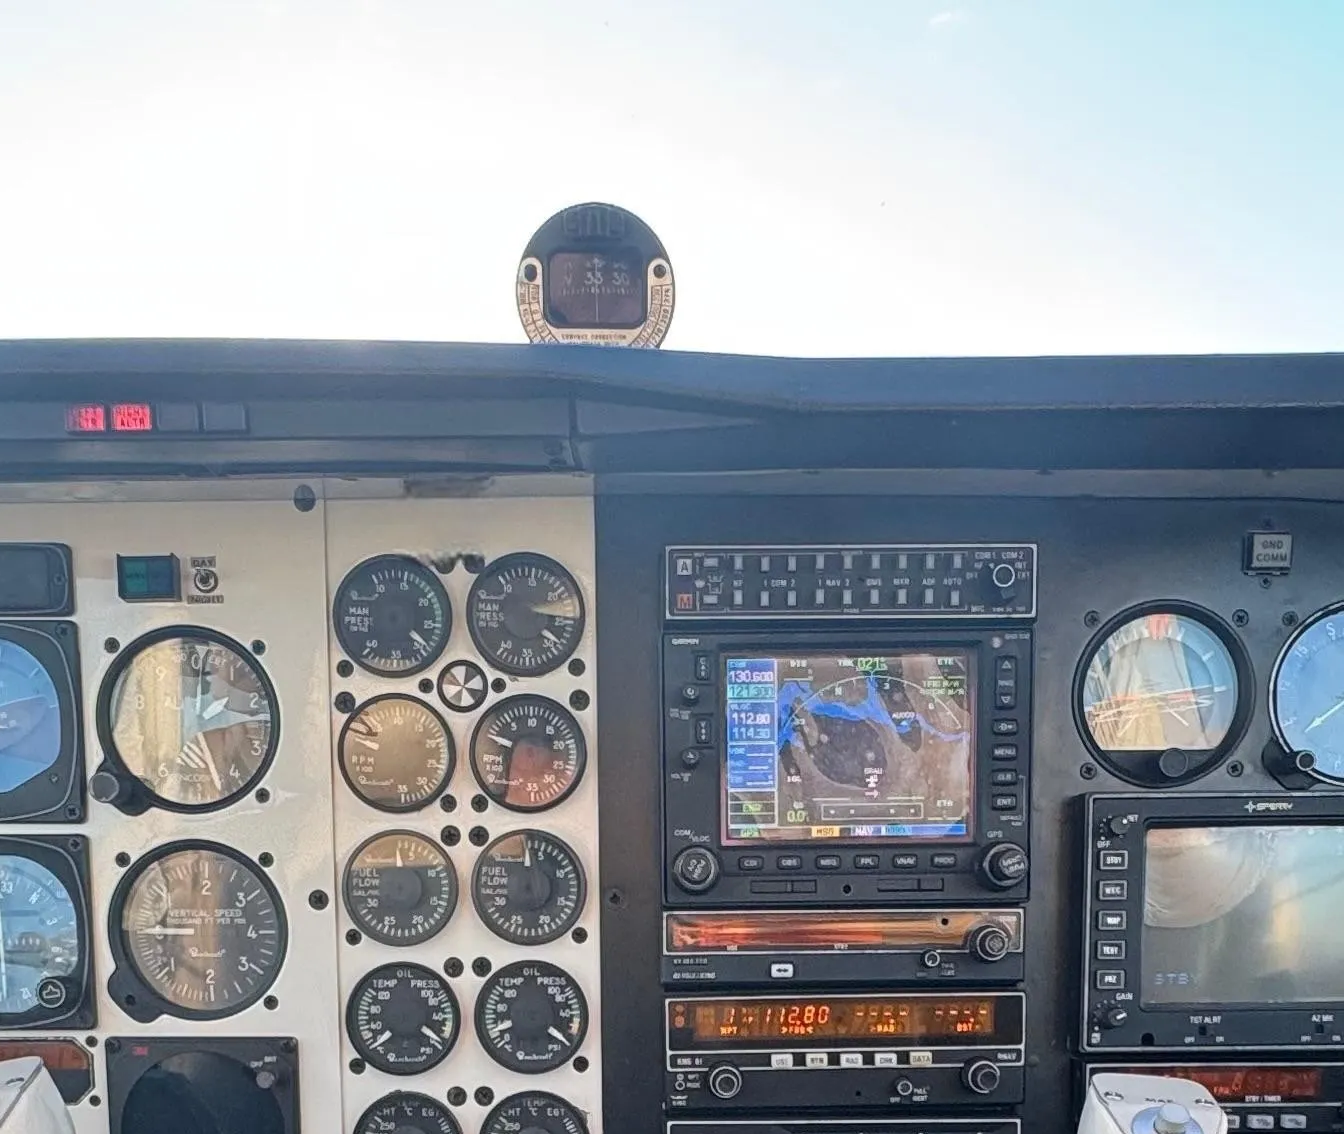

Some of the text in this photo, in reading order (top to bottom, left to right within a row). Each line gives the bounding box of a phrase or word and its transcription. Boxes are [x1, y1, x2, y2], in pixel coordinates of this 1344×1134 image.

[1256, 553, 1288, 563] COMM
[249, 693, 259, 708] 2
[252, 740, 261, 755] 3
[481, 867, 507, 875] FUEL
[353, 878, 380, 886] FLOW
[481, 877, 508, 885] FLOW
[201, 881, 211, 895] 2
[236, 891, 246, 907] 3
[215, 909, 242, 917] SPEED
[247, 925, 258, 939] 4
[239, 957, 249, 971] 3
[206, 970, 215, 984] 2
[397, 970, 413, 978] OIL
[523, 968, 540, 976] OIL
[373, 980, 440, 988] TEMP PRESS
[499, 977, 566, 986] TEMP PRESS
[765, 1006, 830, 1025] 112.80
